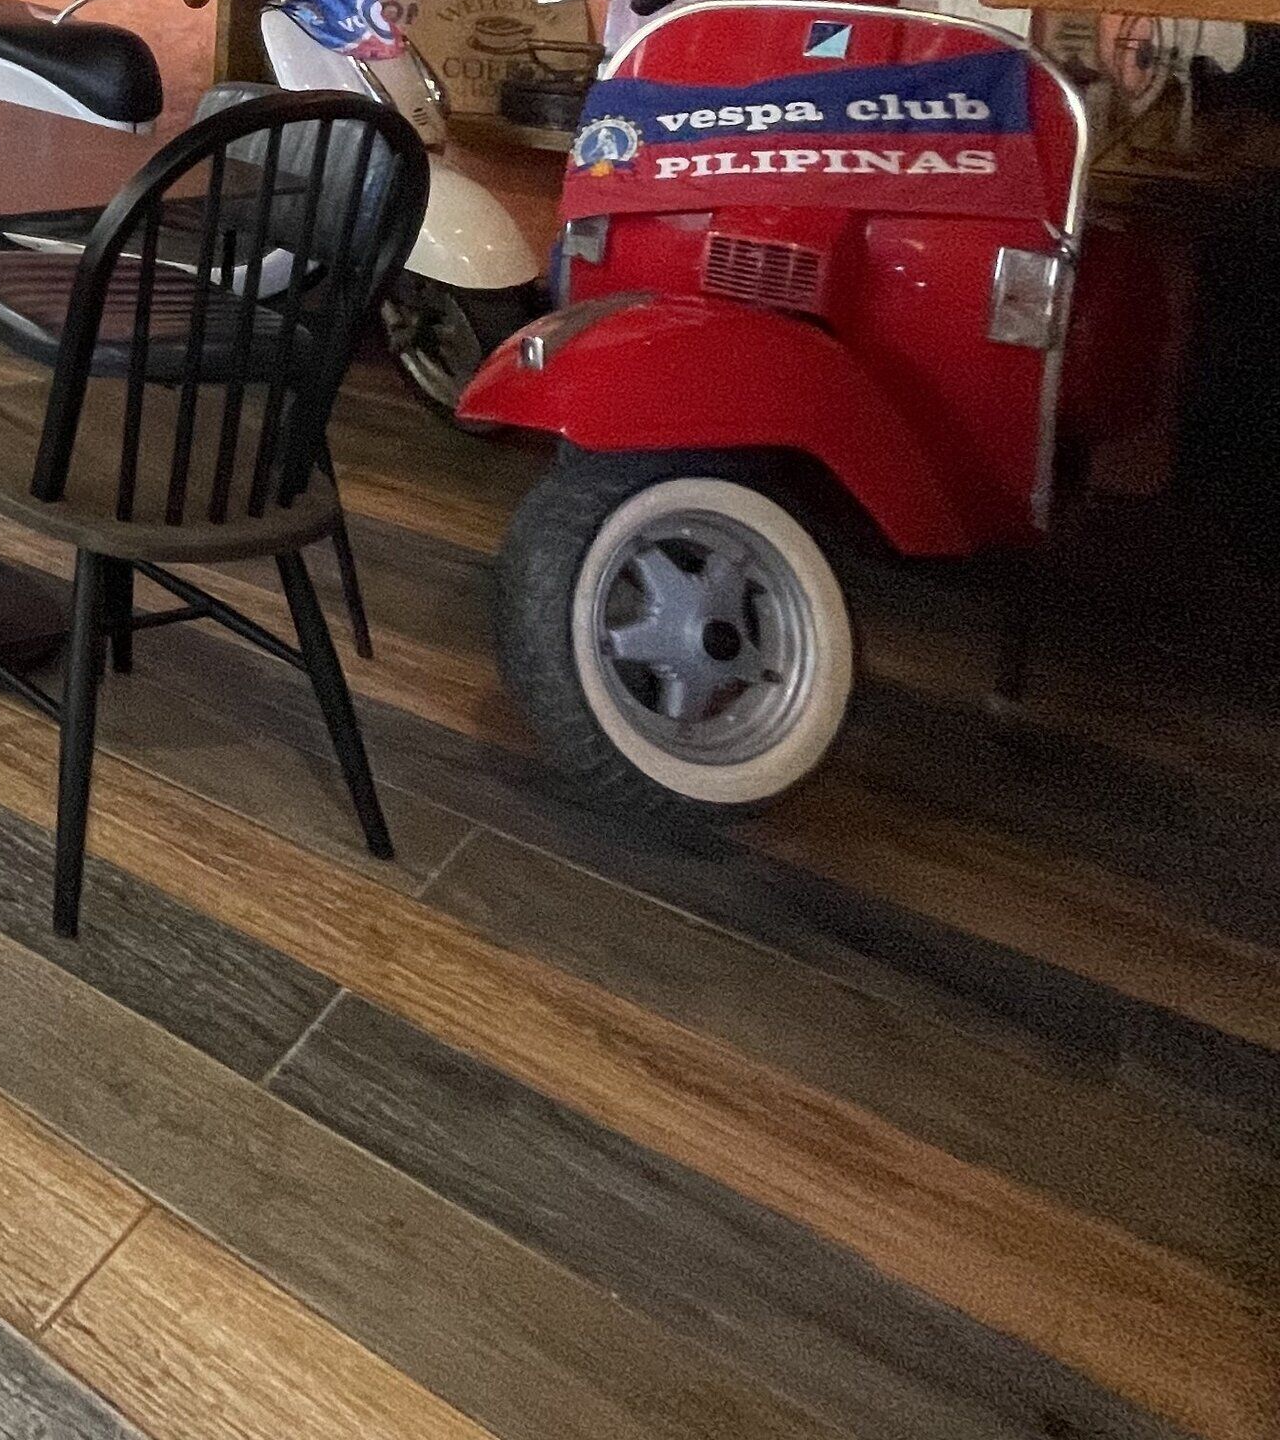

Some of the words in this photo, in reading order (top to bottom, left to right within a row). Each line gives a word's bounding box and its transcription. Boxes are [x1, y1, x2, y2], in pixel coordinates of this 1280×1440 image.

[656, 101, 824, 132] vespa
[845, 92, 990, 121] club
[654, 149, 998, 179] PILIPINAS
